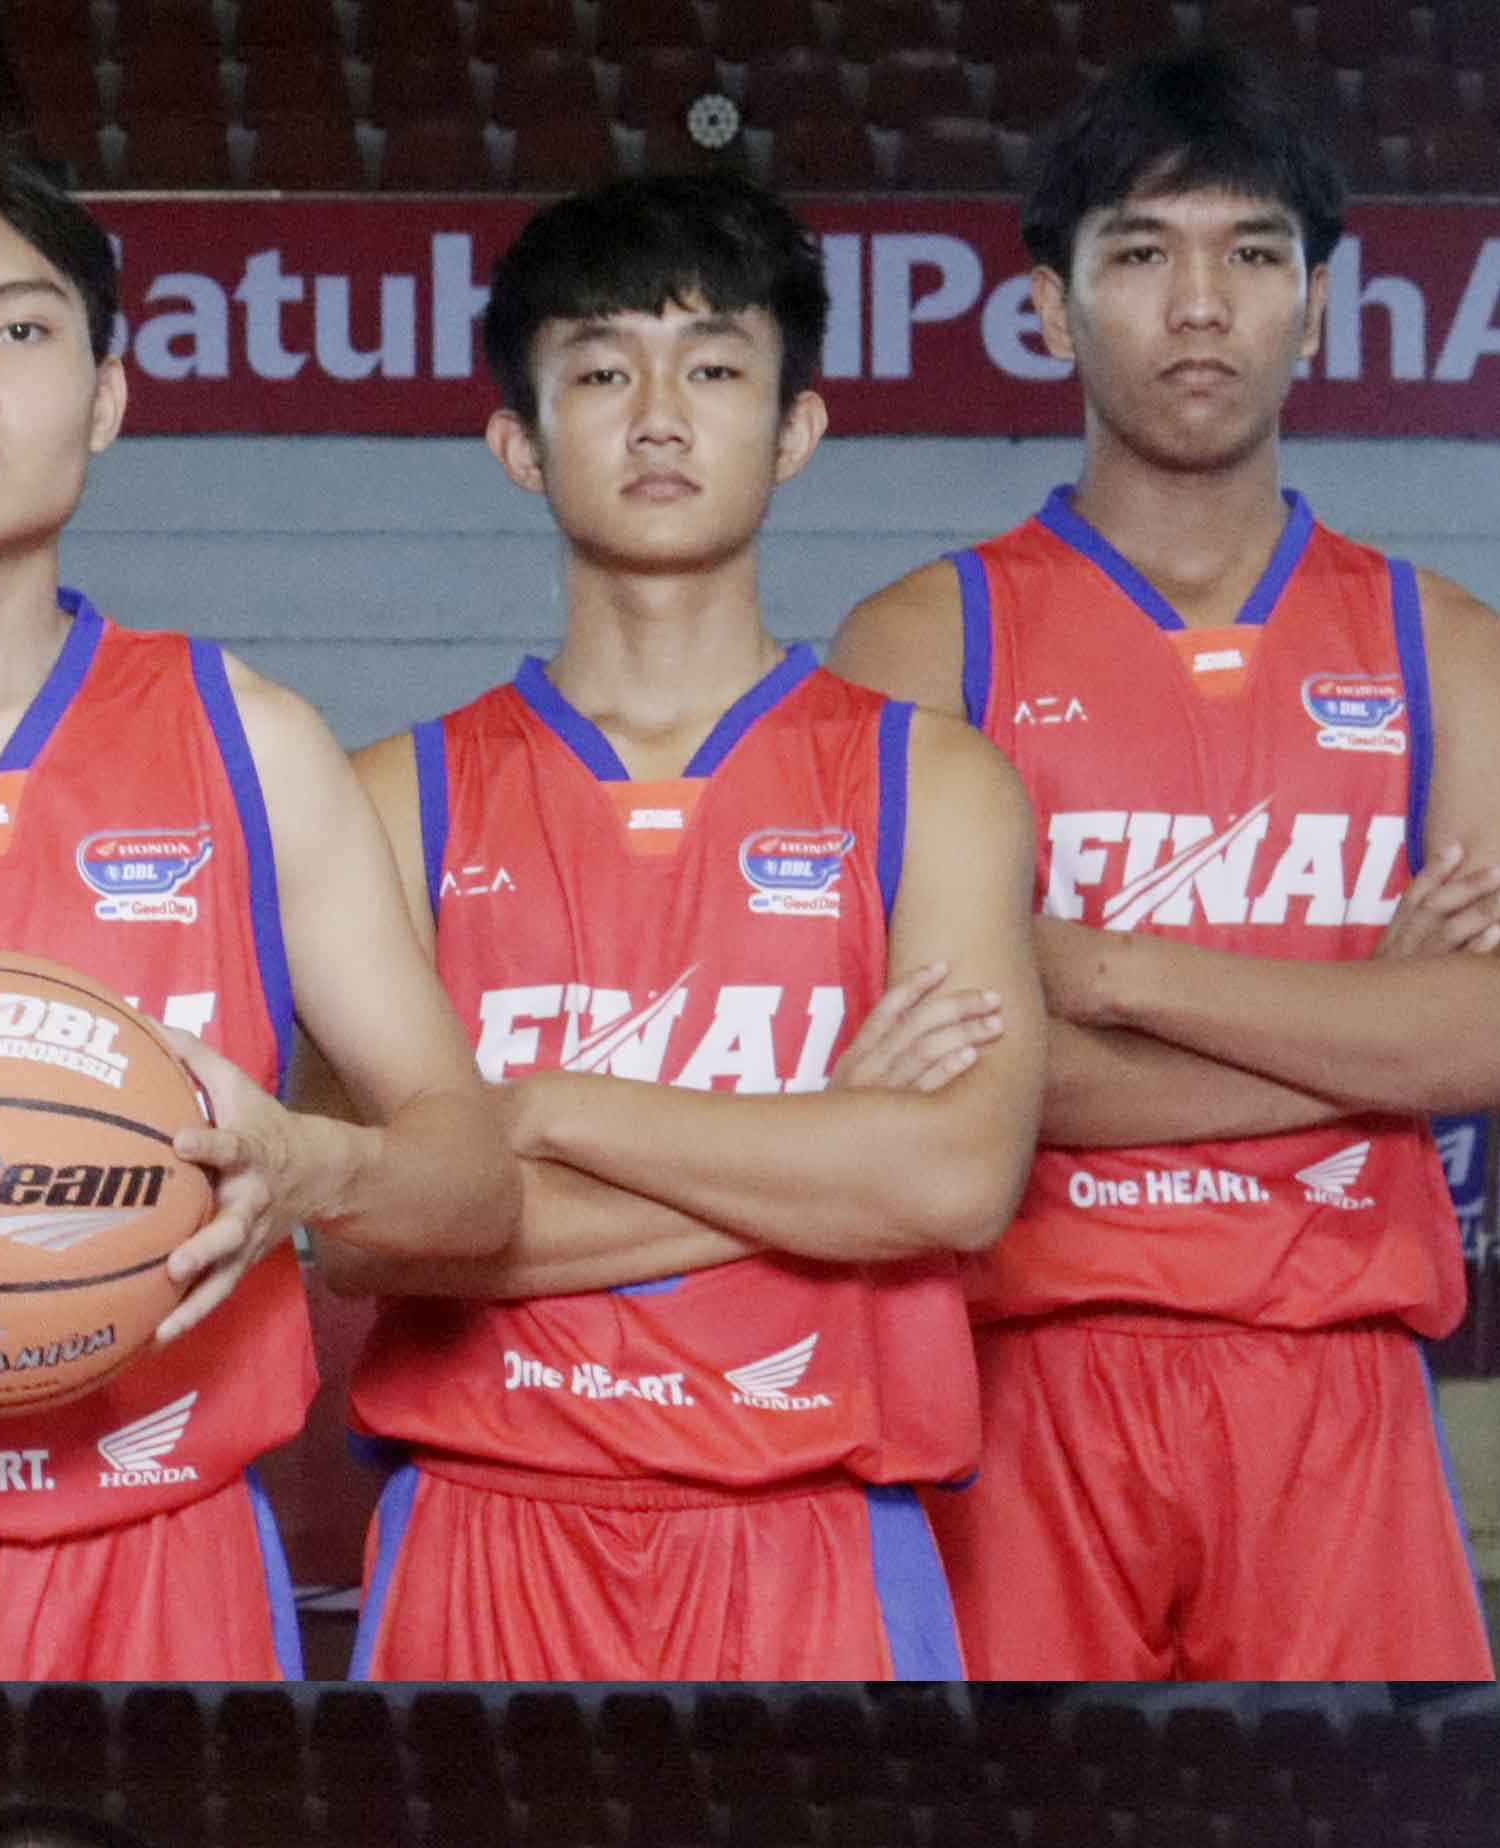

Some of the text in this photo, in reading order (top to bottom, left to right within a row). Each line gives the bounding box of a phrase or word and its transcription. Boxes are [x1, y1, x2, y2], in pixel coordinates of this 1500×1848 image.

[118, 842, 191, 857] HONDA
[121, 863, 158, 881] DBL
[1043, 806, 1407, 931] FINAL
[1068, 1170, 1138, 1210] One
[98, 1466, 199, 1488] HONDA
